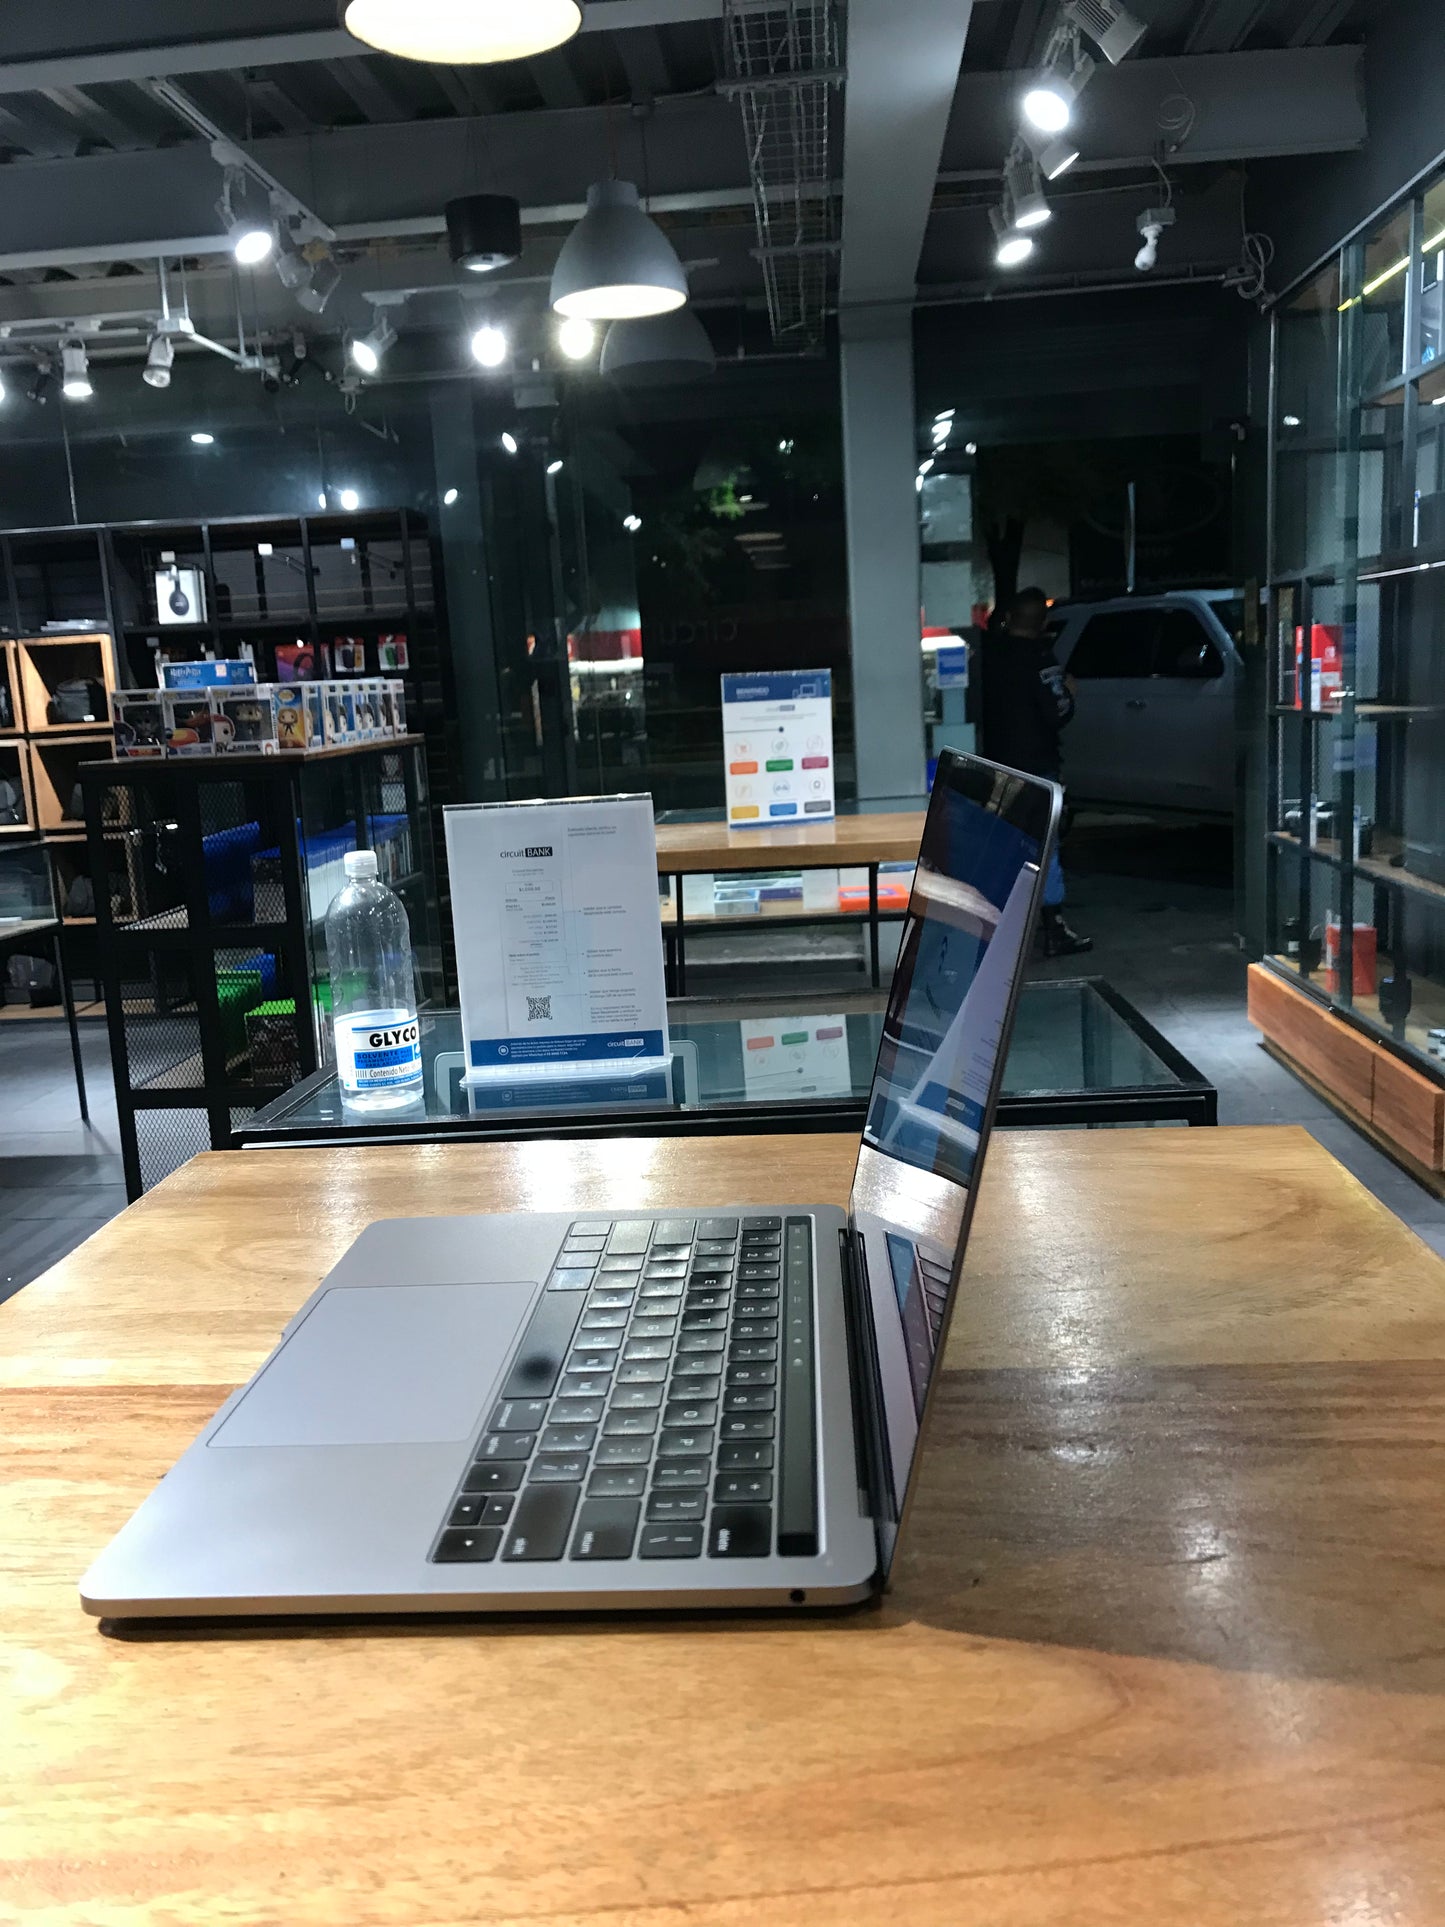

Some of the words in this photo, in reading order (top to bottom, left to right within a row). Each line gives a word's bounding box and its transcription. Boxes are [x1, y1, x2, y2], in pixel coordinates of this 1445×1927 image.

[500, 849, 524, 858] circuit
[527, 847, 551, 857] BANK
[369, 1026, 416, 1048] GLYCO
